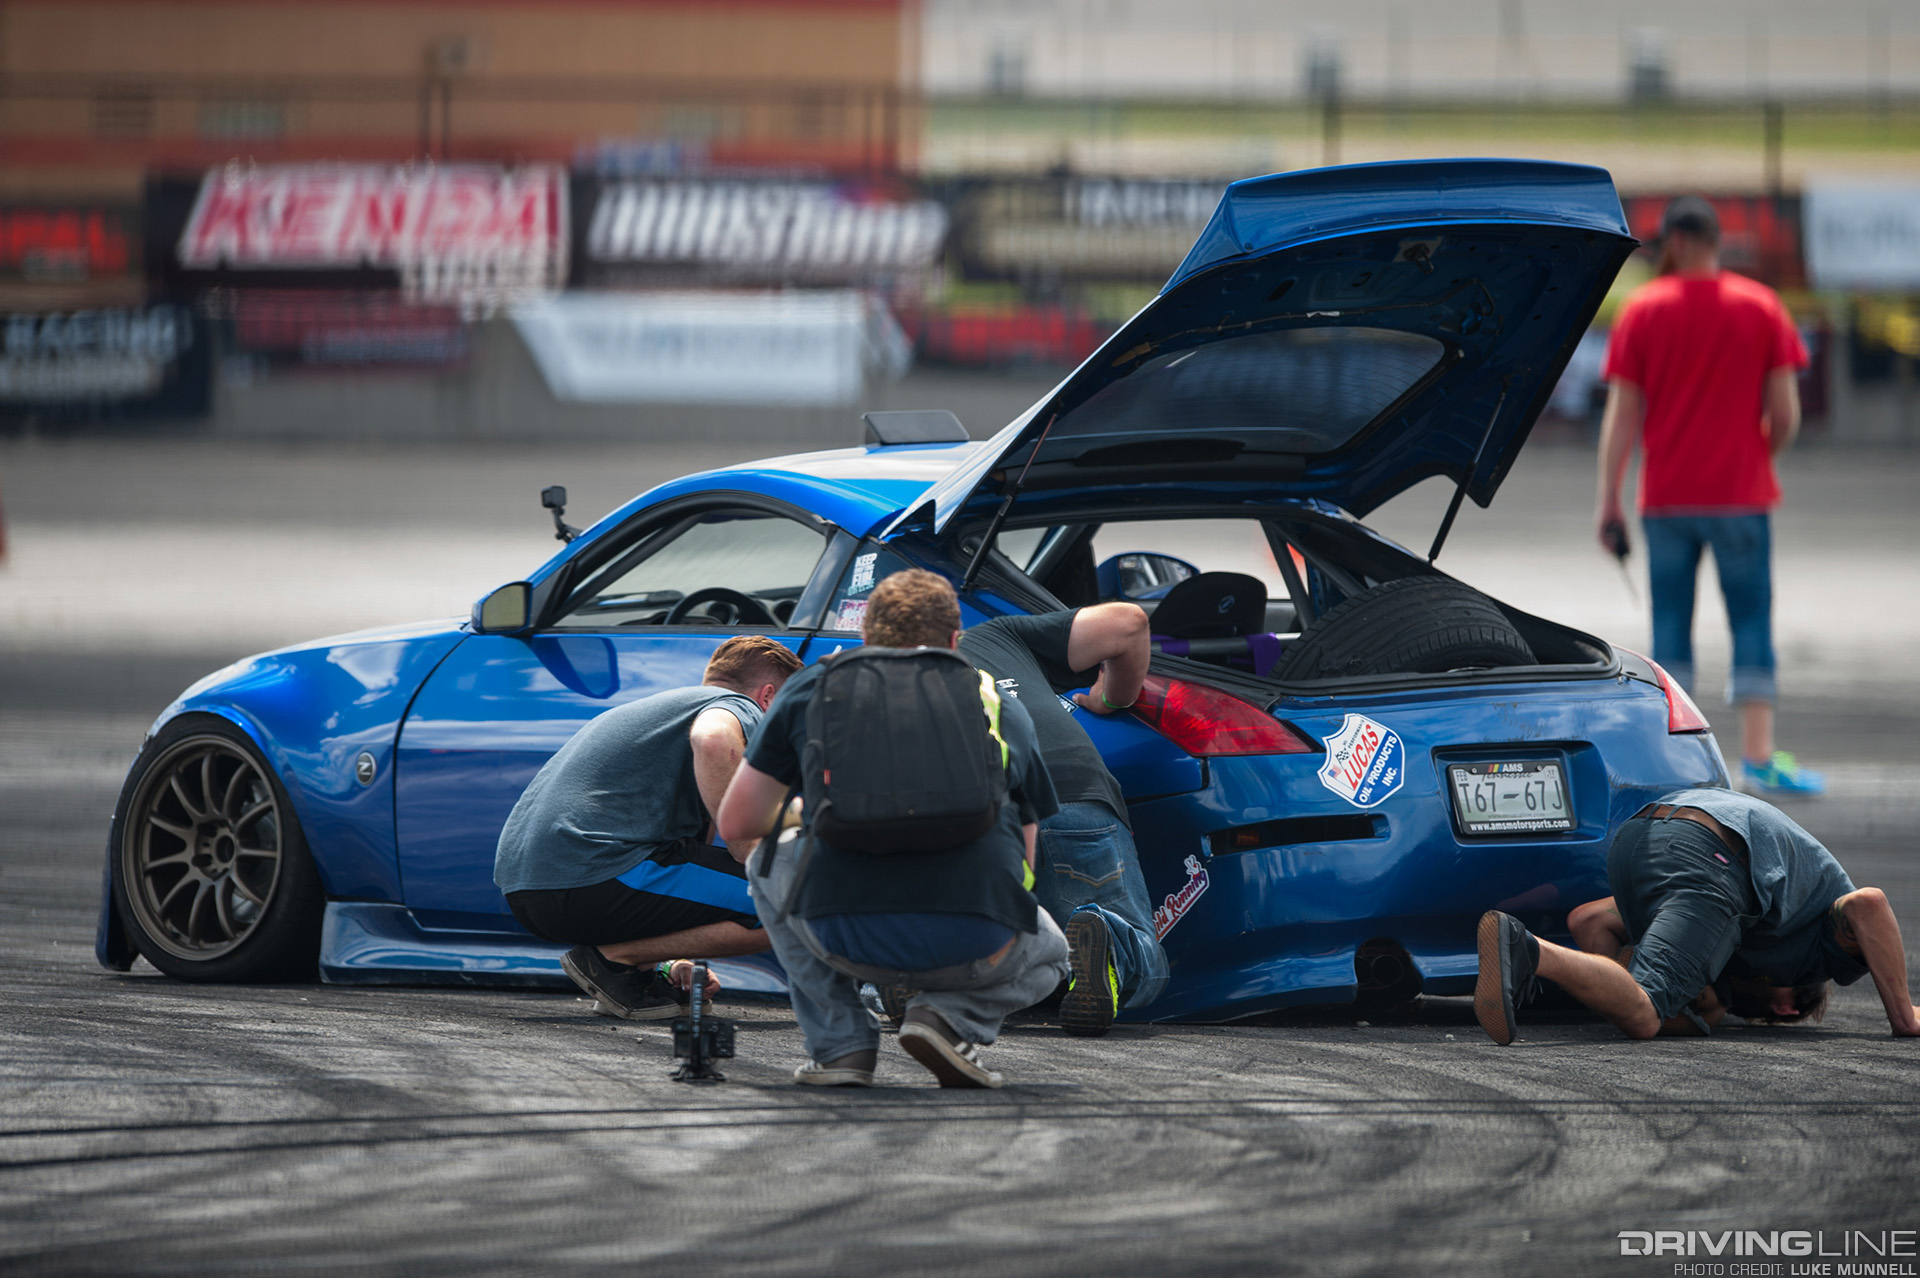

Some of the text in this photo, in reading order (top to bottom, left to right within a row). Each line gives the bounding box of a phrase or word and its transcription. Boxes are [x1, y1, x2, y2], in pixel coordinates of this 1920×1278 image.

[185, 166, 538, 268] KENDA
[1344, 724, 1379, 791] LUCAS
[1359, 735, 1397, 803] OIL PRODUCTS
[1456, 770, 1468, 781] FEB
[1502, 763, 1523, 773] AMS
[1470, 820, 1570, 831] www.amsmotorsports.com
[1166, 870, 1209, 918] Running
